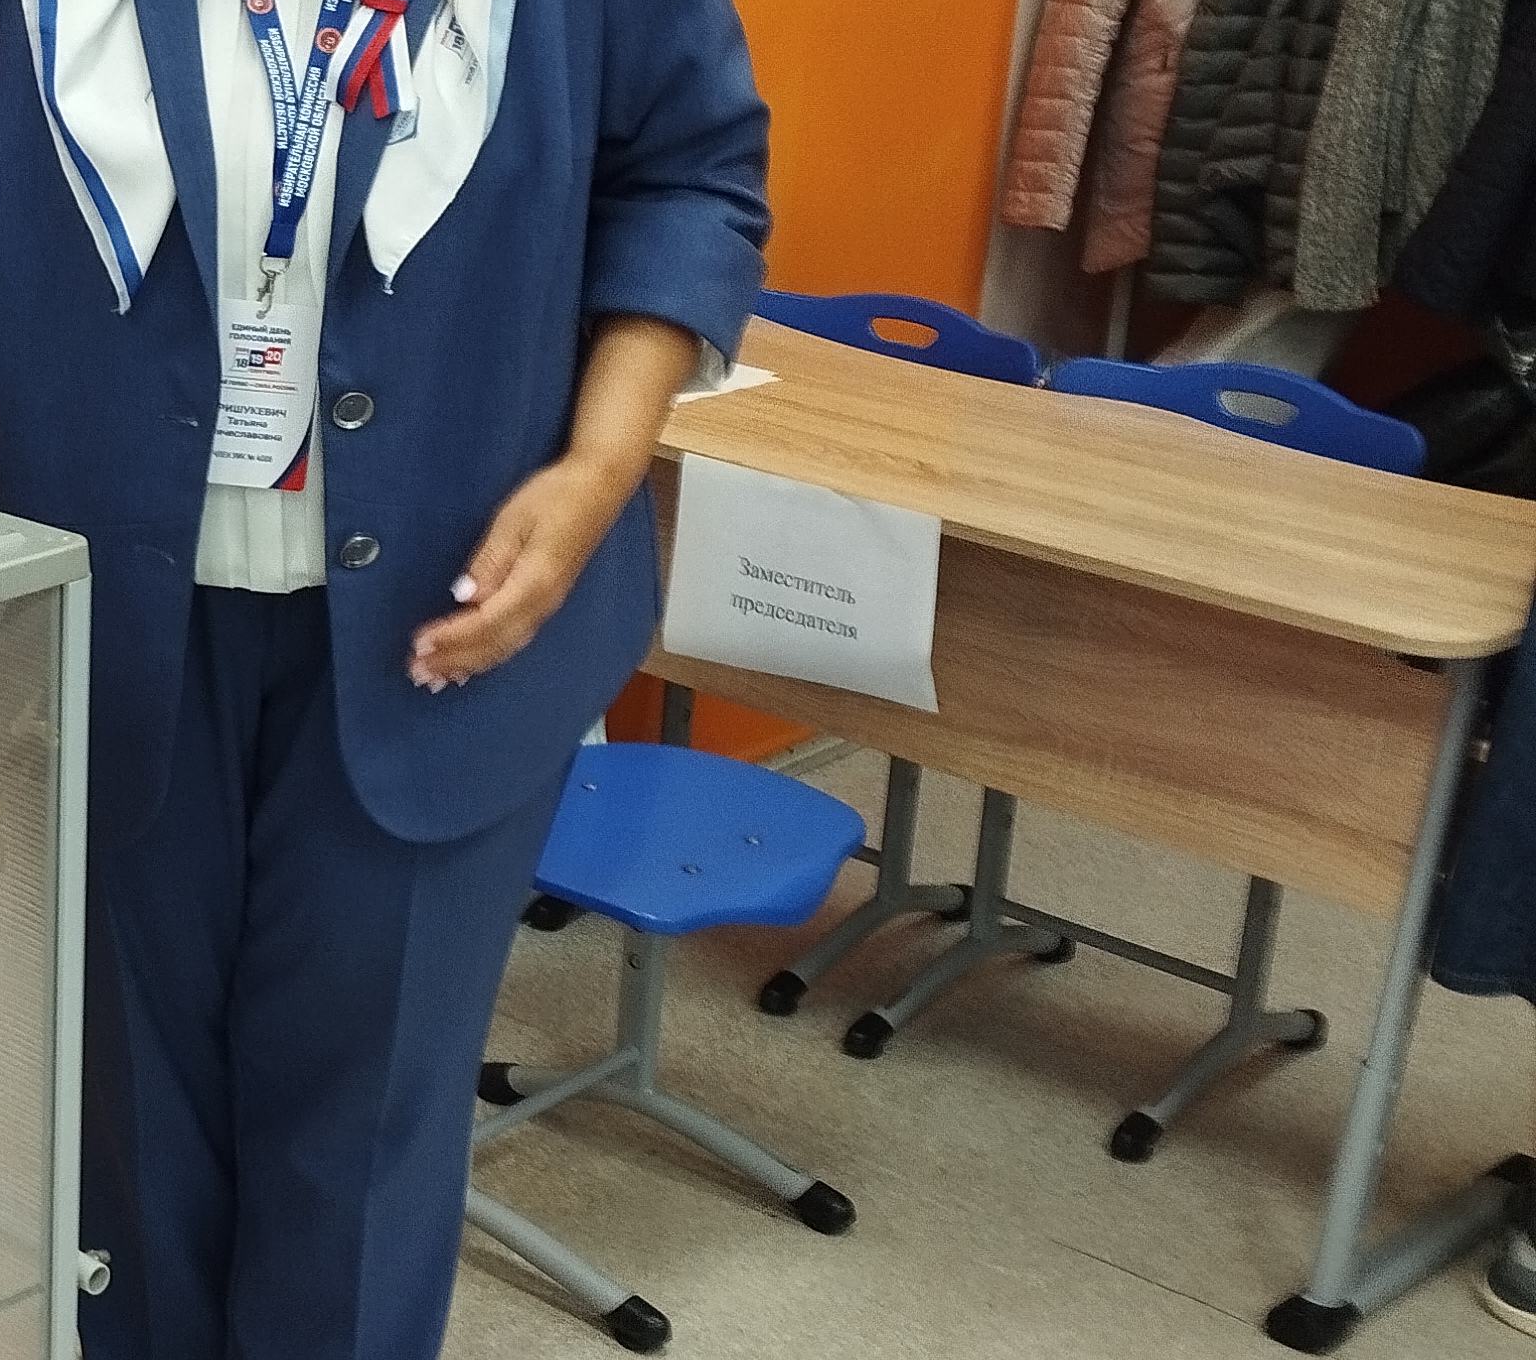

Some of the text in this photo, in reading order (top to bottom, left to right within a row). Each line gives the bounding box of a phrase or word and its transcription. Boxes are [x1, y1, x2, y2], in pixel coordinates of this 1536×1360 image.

[258, 39, 289, 150] МОСКОВСКОЙ ОБЛАСТИ
[267, 28, 297, 103] ИЗБИРАТЕЛЬНАЯ
[277, 66, 322, 208] ИЗБИРАТЕЛЬНАЯ КОМИССИЯ
[294, 127, 322, 198] МОСКОВСКОЙ
[228, 332, 292, 345] ГОЛОСОВАНИЯ
[235, 350, 282, 368] 18 19 20
[737, 555, 856, 604] Заместитель
[731, 593, 858, 640] председателя
